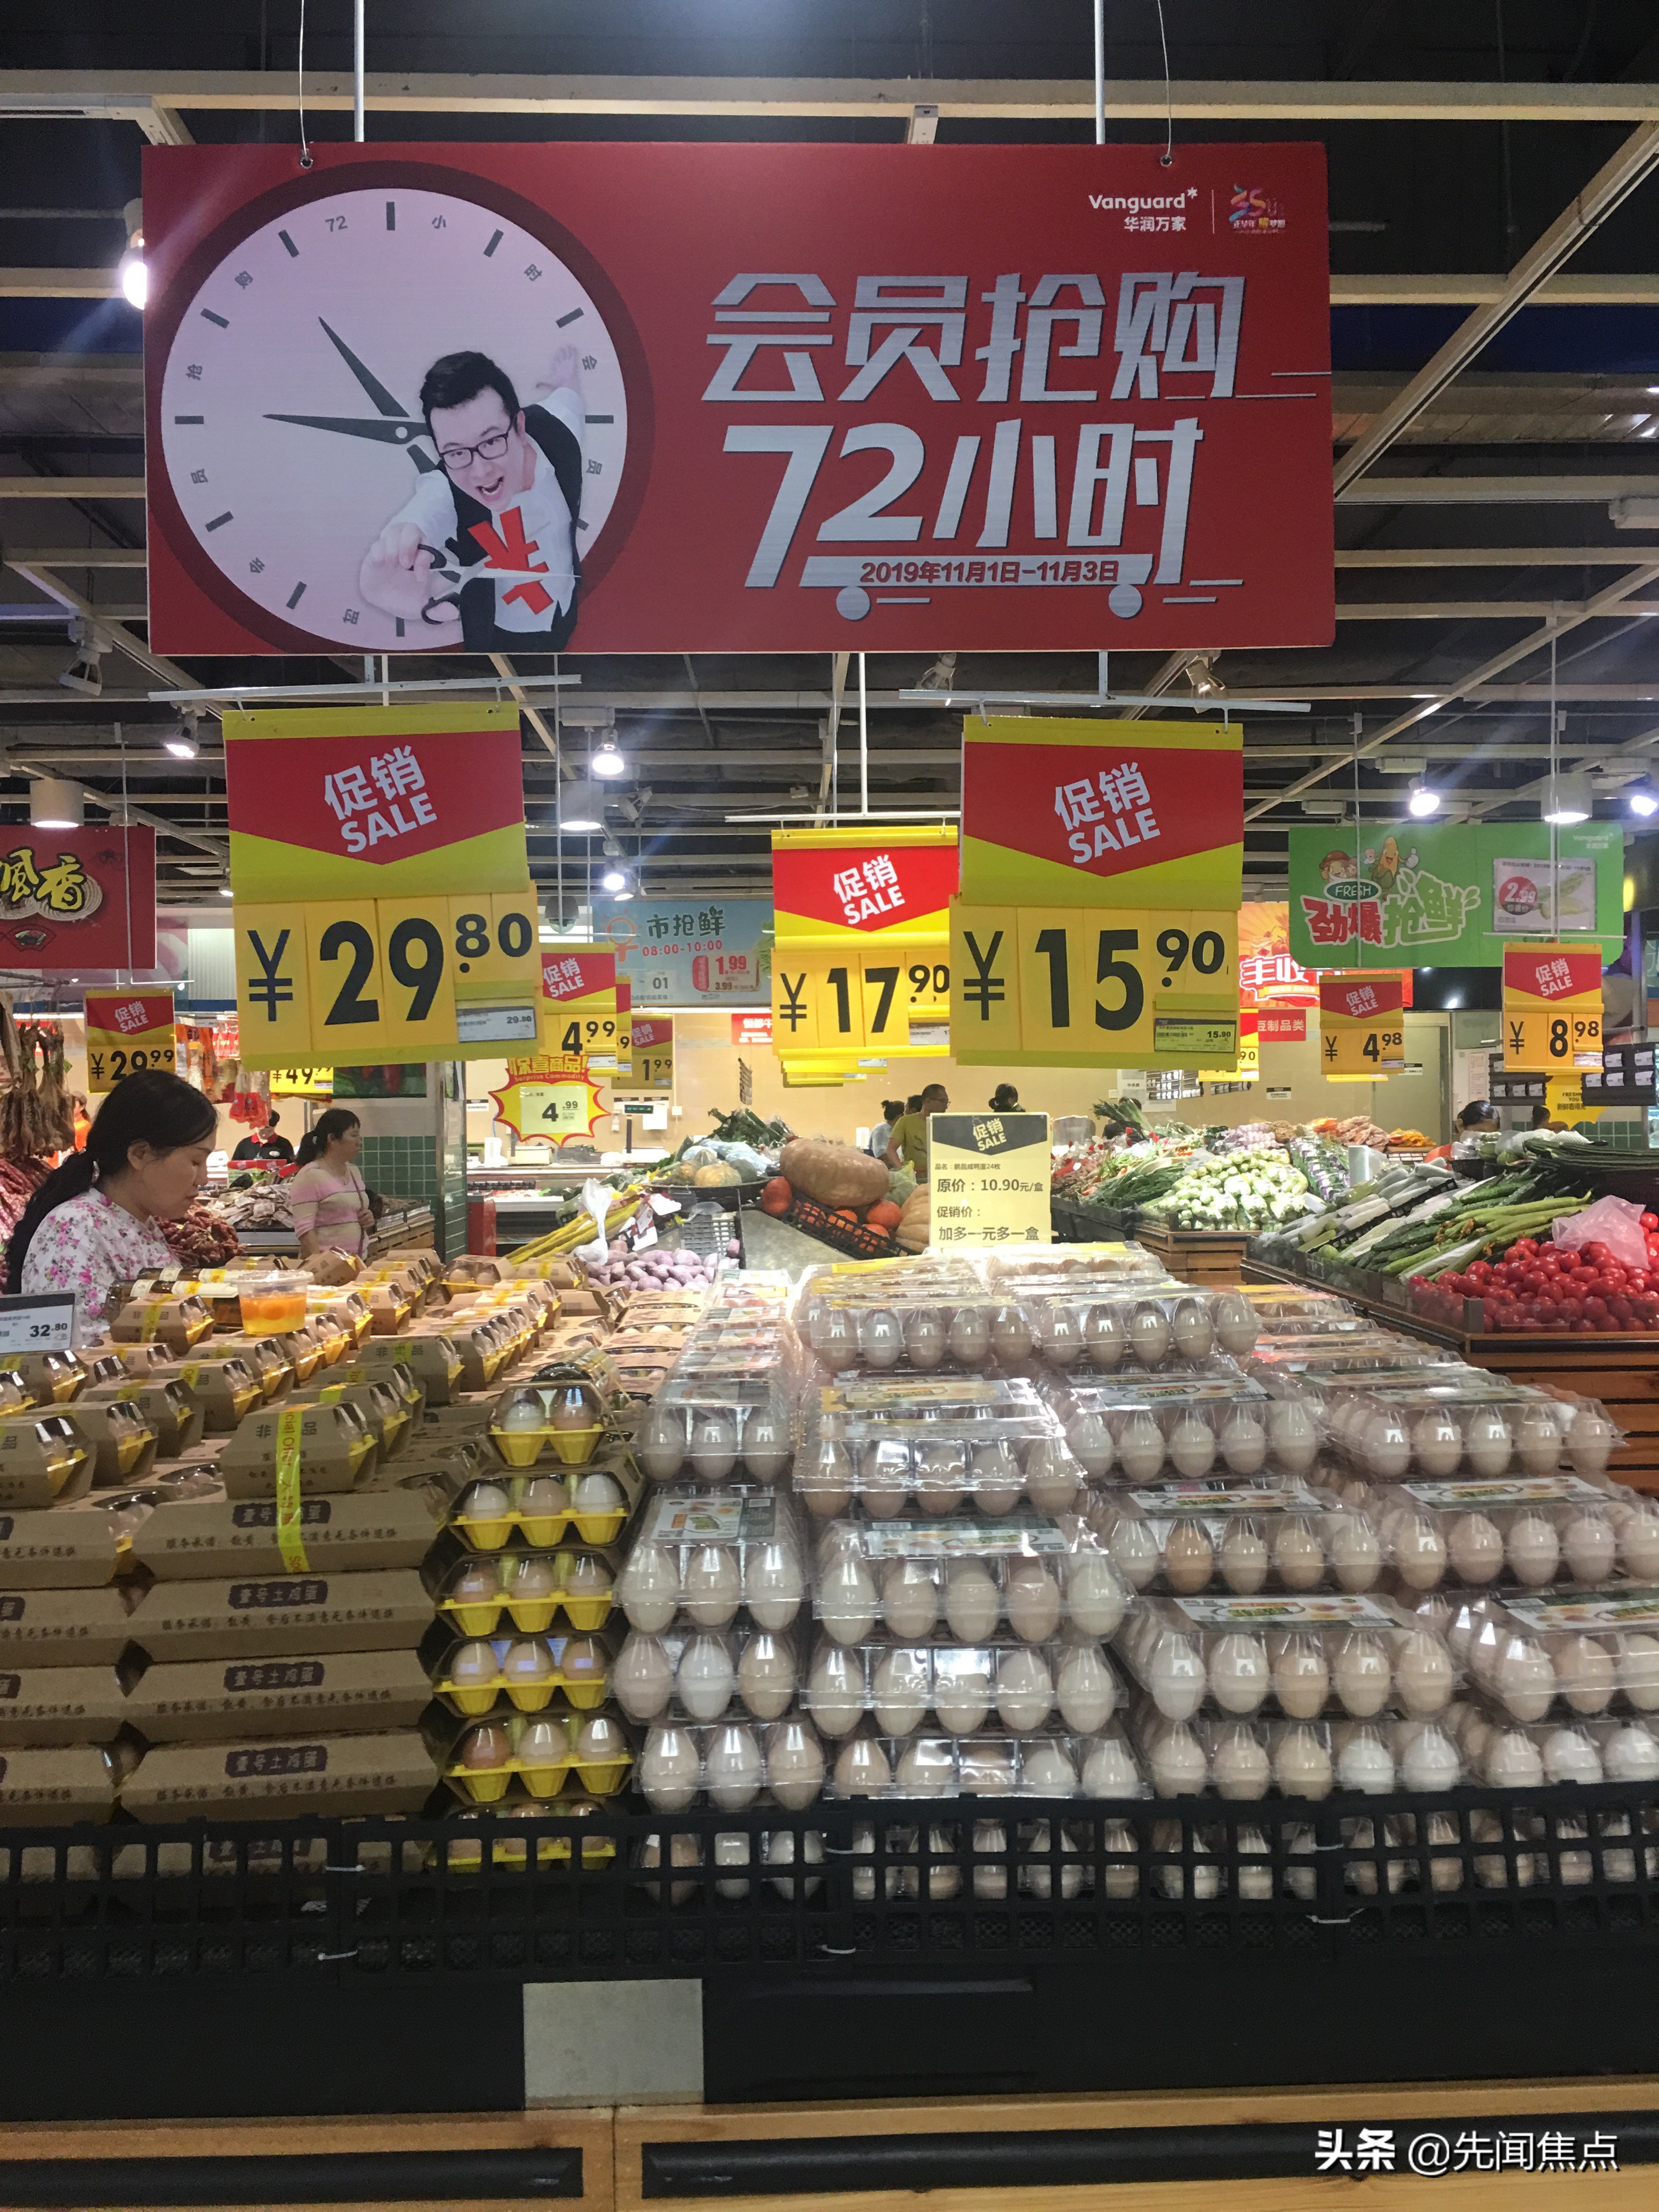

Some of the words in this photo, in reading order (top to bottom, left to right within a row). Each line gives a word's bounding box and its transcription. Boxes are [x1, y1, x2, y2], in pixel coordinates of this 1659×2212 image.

[1088, 194, 1186, 213] Vanguard
[325, 216, 348, 232] 72
[1124, 216, 1186, 232] 华润万家
[701, 272, 1245, 402] 会员抢购
[723, 418, 1203, 588] 72小时
[860, 561, 1119, 583] 2019年11月1日-11月3日
[324, 746, 426, 820] 促销
[1054, 762, 1150, 831] 促销
[341, 793, 437, 853] SALE
[1068, 808, 1160, 864] SALE
[833, 854, 898, 904] 促销
[1335, 885, 1372, 896] FRESH
[1505, 882, 1536, 903] 2.99
[843, 885, 905, 924] SALE
[1301, 871, 1470, 946] 劲爆抢鲜
[642, 940, 723, 956] 08:00-10:00
[543, 957, 580, 986] 促销
[715, 955, 747, 974] 1.99
[1536, 958, 1570, 984] 促销
[549, 975, 585, 997] SALE
[1345, 986, 1375, 1007] 促销
[1541, 975, 1573, 996] SALE
[115, 1001, 145, 1024] 促销
[1351, 999, 1378, 1017] SALE
[120, 1015, 149, 1032] SALE
[642, 1059, 672, 1081] 1.99
[973, 1118, 1004, 1141] 促销
[977, 1133, 1007, 1152] SALE
[938, 1226, 1040, 1241] 加多一元多一盒
[30, 1323, 67, 1338] 32.80
